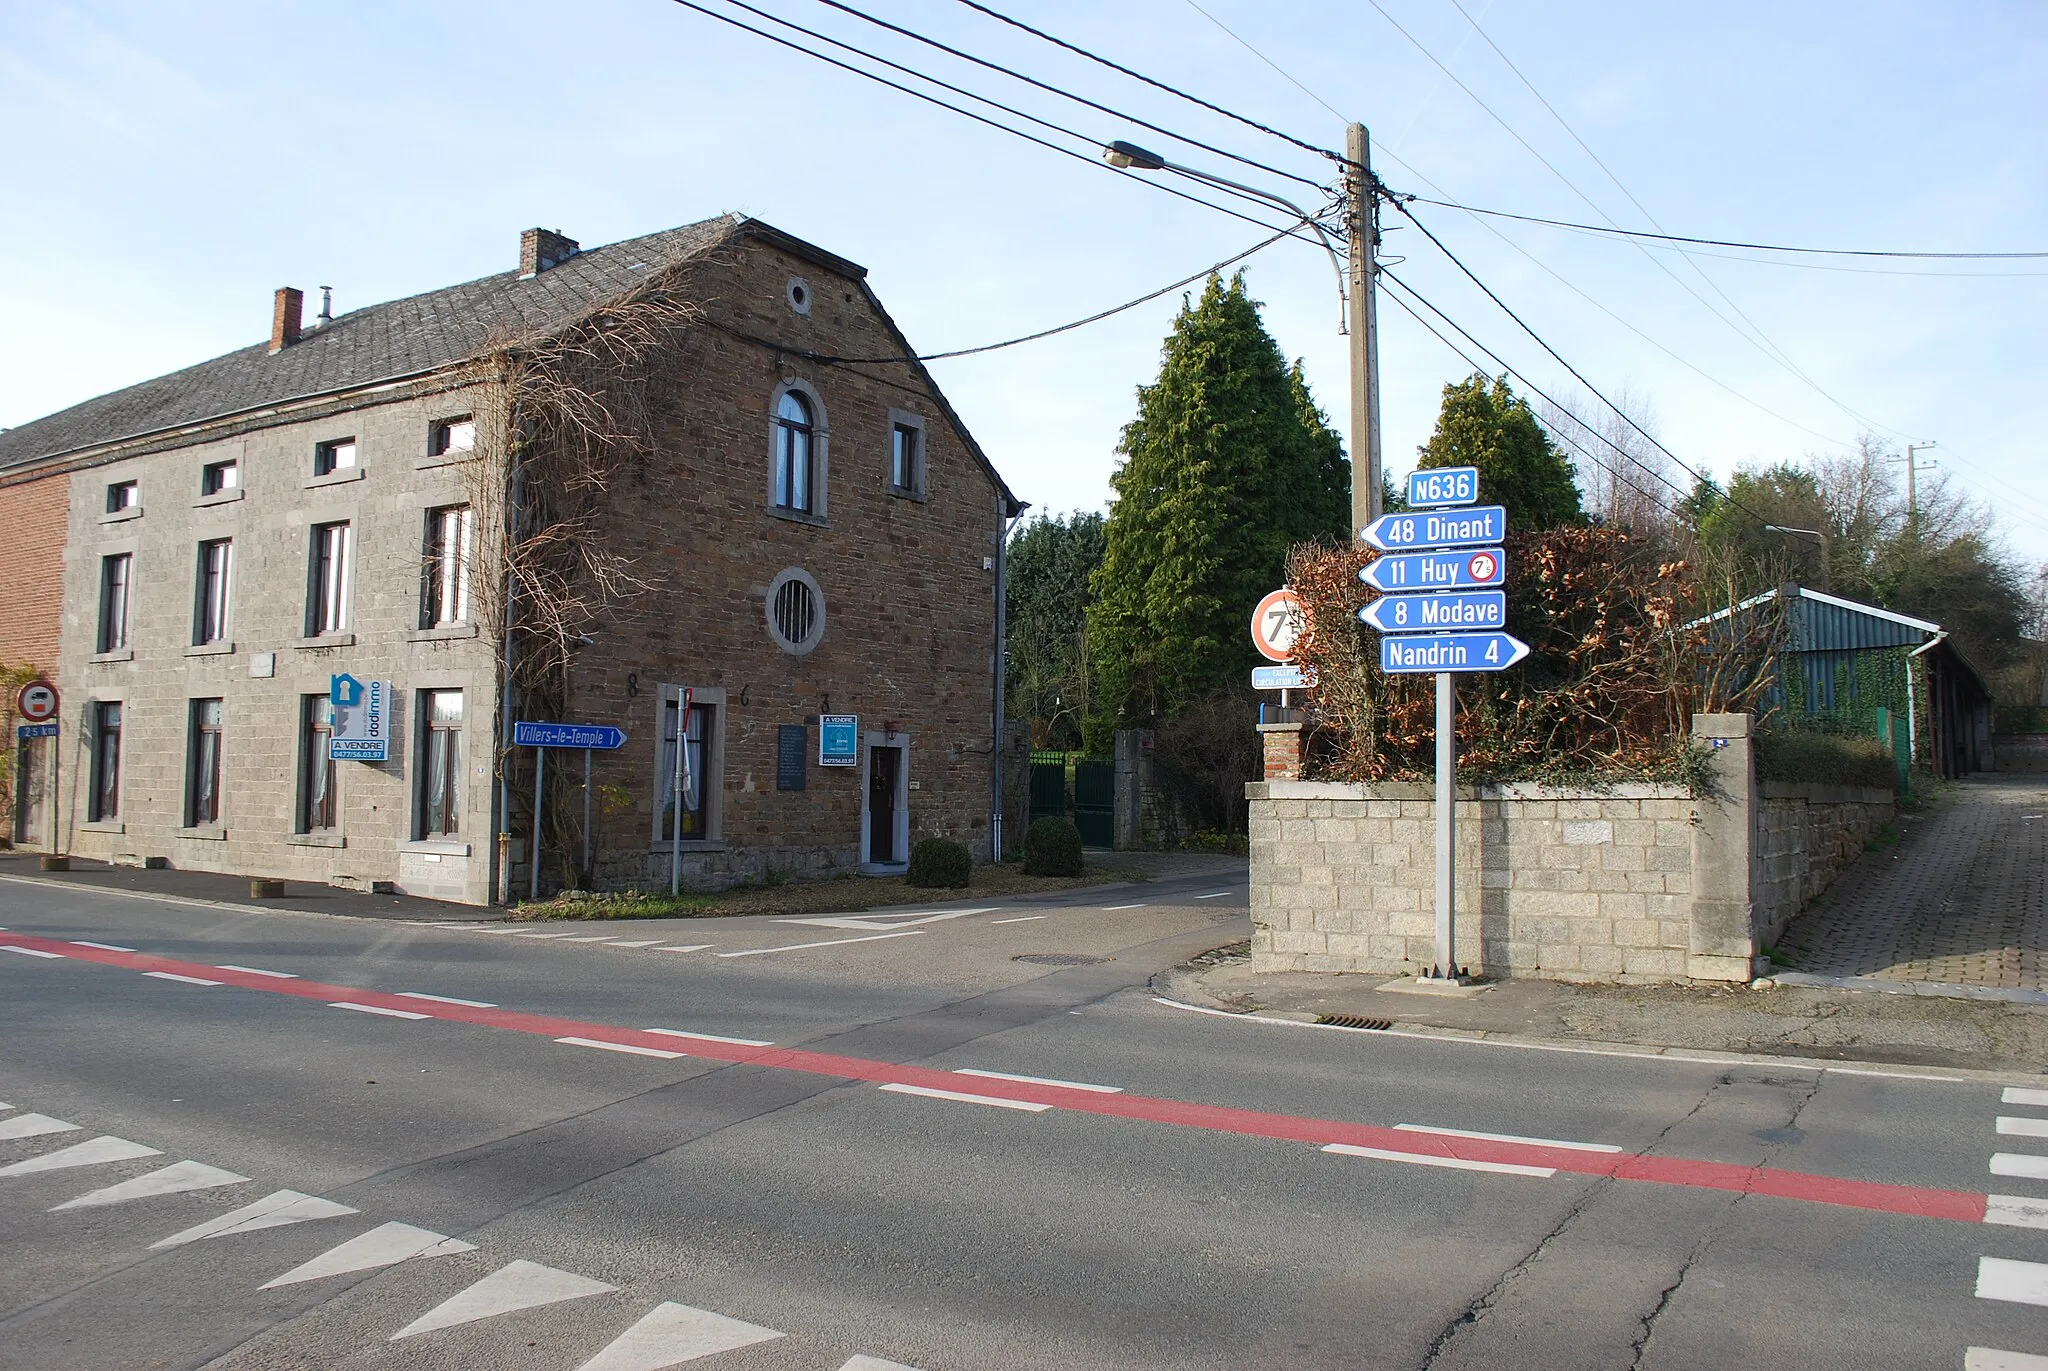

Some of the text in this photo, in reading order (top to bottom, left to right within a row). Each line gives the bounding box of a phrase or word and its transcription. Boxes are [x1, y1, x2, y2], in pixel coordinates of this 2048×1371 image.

[1415, 473, 1470, 501] N636
[1387, 513, 1493, 544] 48 Dinant
[1390, 558, 1459, 587] 11 Huy
[1394, 599, 1499, 625] 8 Modave
[1268, 610, 1288, 643] 7
[1389, 639, 1499, 667] Nandrin 4
[368, 681, 381, 737] dodimmo
[40, 725, 57, 736] km
[519, 725, 615, 748] Villers-le-Temple 1
[344, 742, 383, 750] VENDRE
